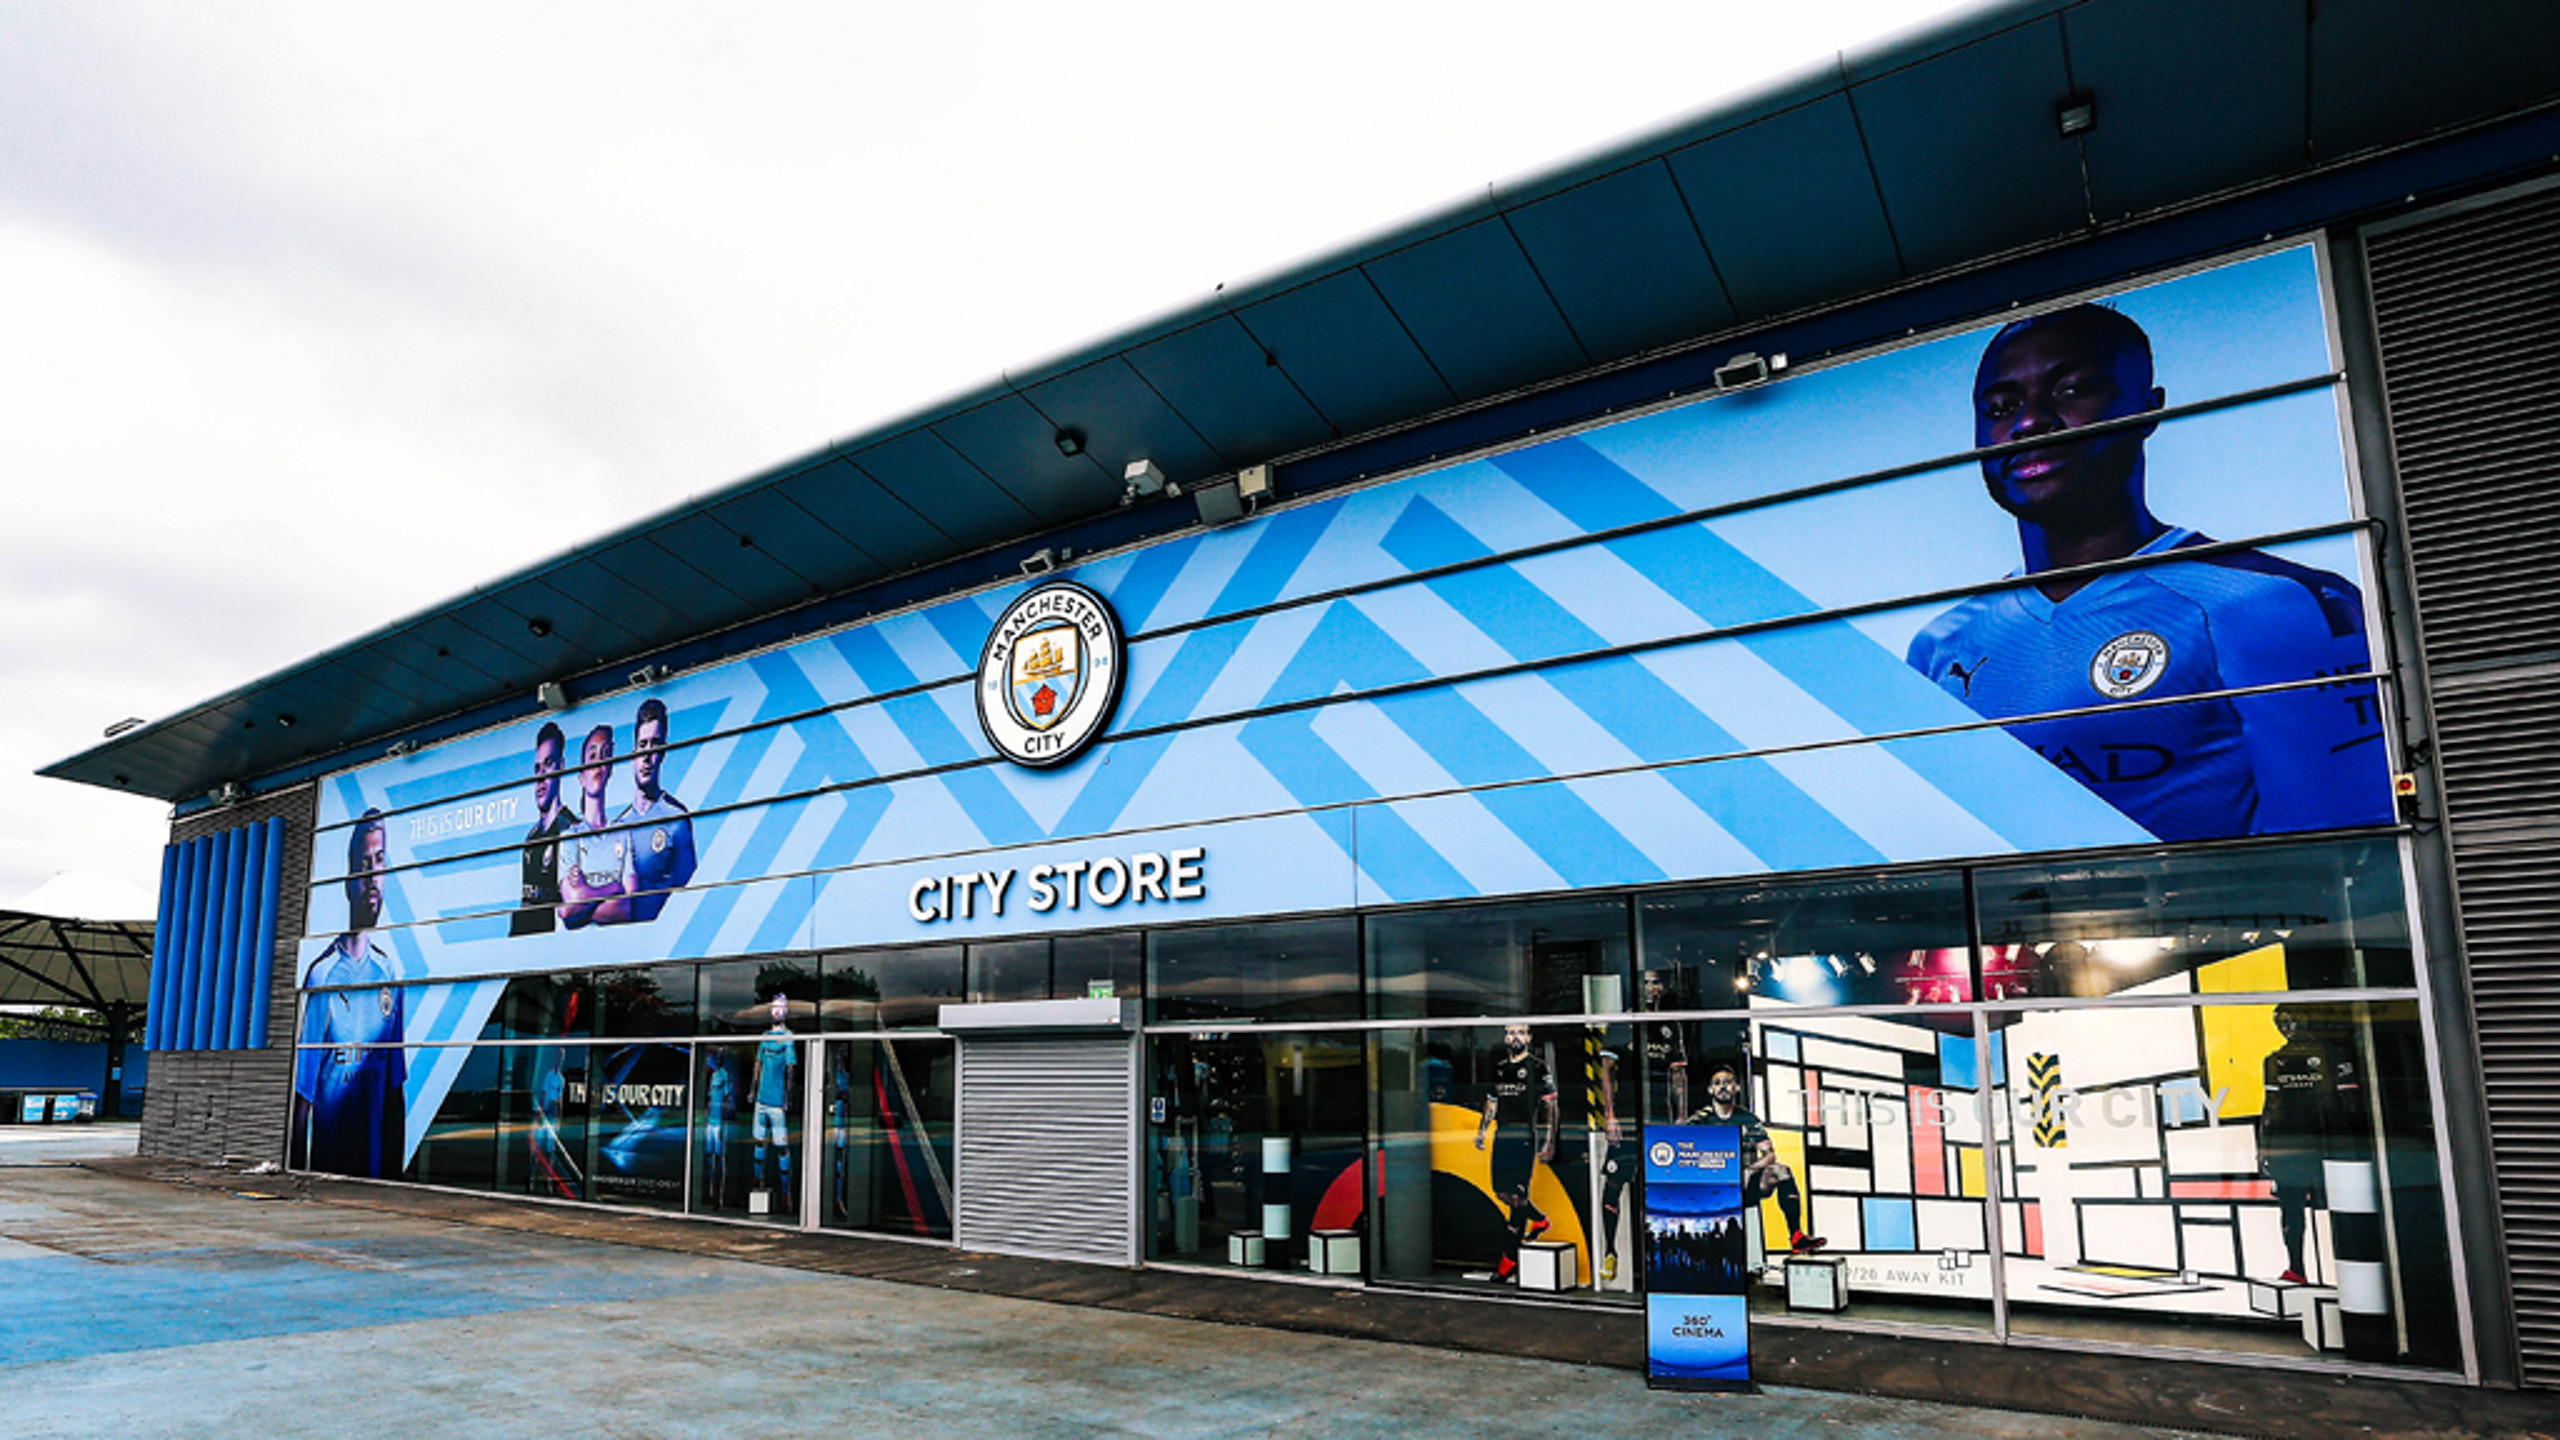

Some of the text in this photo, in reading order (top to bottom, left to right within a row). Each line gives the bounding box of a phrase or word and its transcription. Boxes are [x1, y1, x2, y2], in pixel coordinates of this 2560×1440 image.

[993, 595, 1103, 661] MANCHESTER
[1024, 732, 1065, 753] CITY
[410, 797, 518, 839] THIS IS OUR CITY
[909, 847, 1205, 922] CITY STORE
[602, 1084, 617, 1104] IS
[618, 1084, 651, 1106] OUR
[651, 1085, 685, 1106] CITY
[1787, 1087, 2229, 1127] THIS IS OUR CITY
[1886, 1270, 1931, 1283] AWAY
[1939, 1273, 1965, 1286] KIT
[1672, 1327, 1724, 1338] CINEMA
